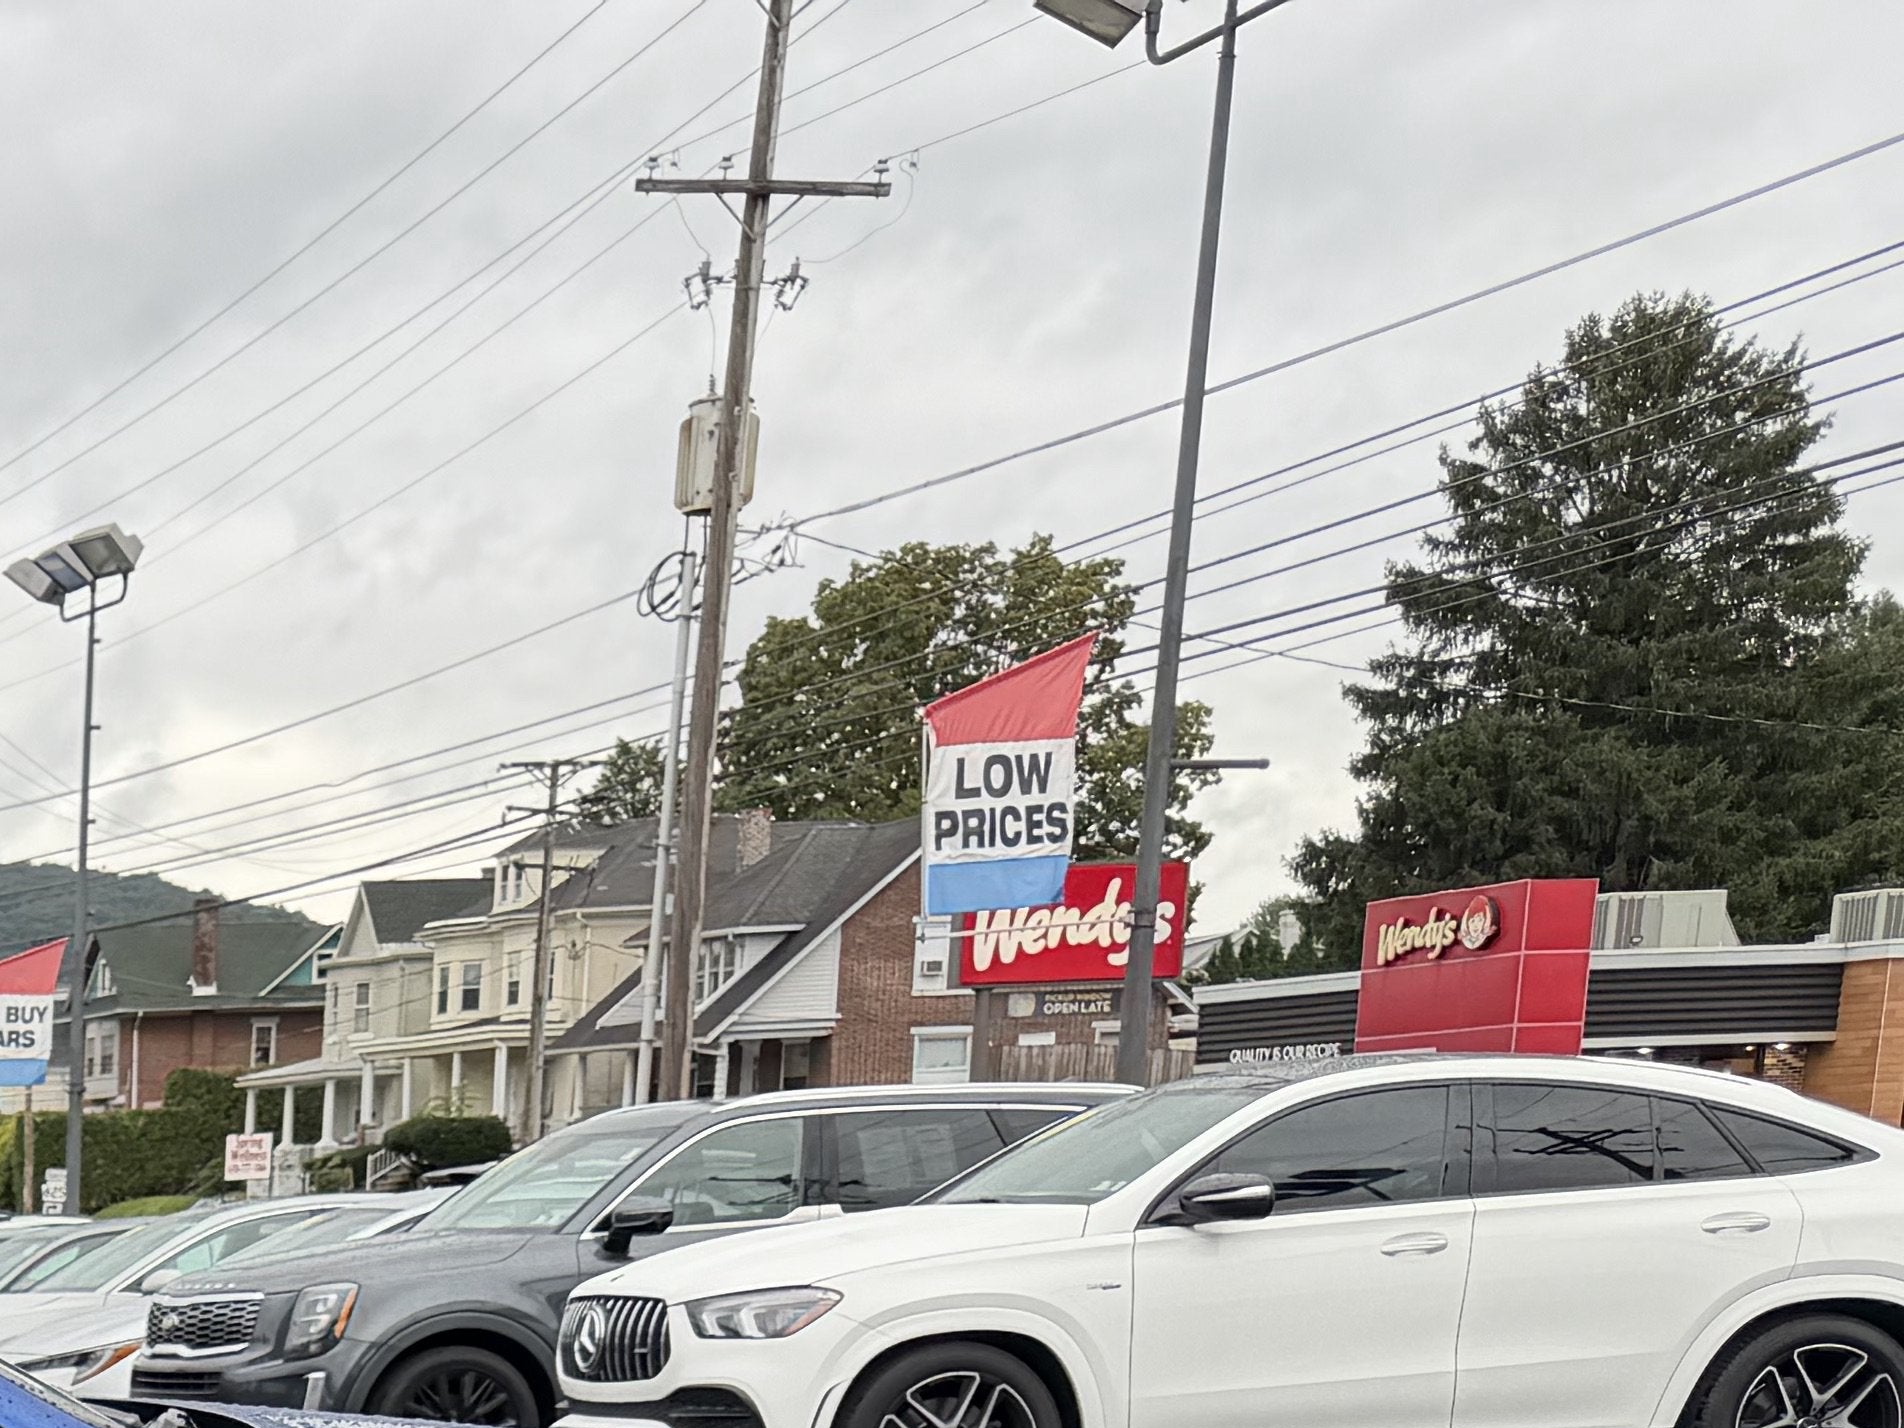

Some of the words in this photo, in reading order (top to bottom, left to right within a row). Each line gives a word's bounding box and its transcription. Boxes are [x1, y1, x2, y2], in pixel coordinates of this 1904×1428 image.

[954, 751, 1053, 800] LOW
[934, 802, 1070, 851] PRICES
[972, 877, 1176, 972] Wendys
[1377, 906, 1457, 966] Wendy's
[6, 1006, 49, 1024] BUY
[1043, 1002, 1079, 1014] OPEN
[1080, 1000, 1112, 1013] LATE
[1229, 1047, 1271, 1063] QUALITY
[1272, 1046, 1281, 1061] IS
[1283, 1045, 1304, 1061] OUR
[1305, 1042, 1343, 1059] RECIPE
